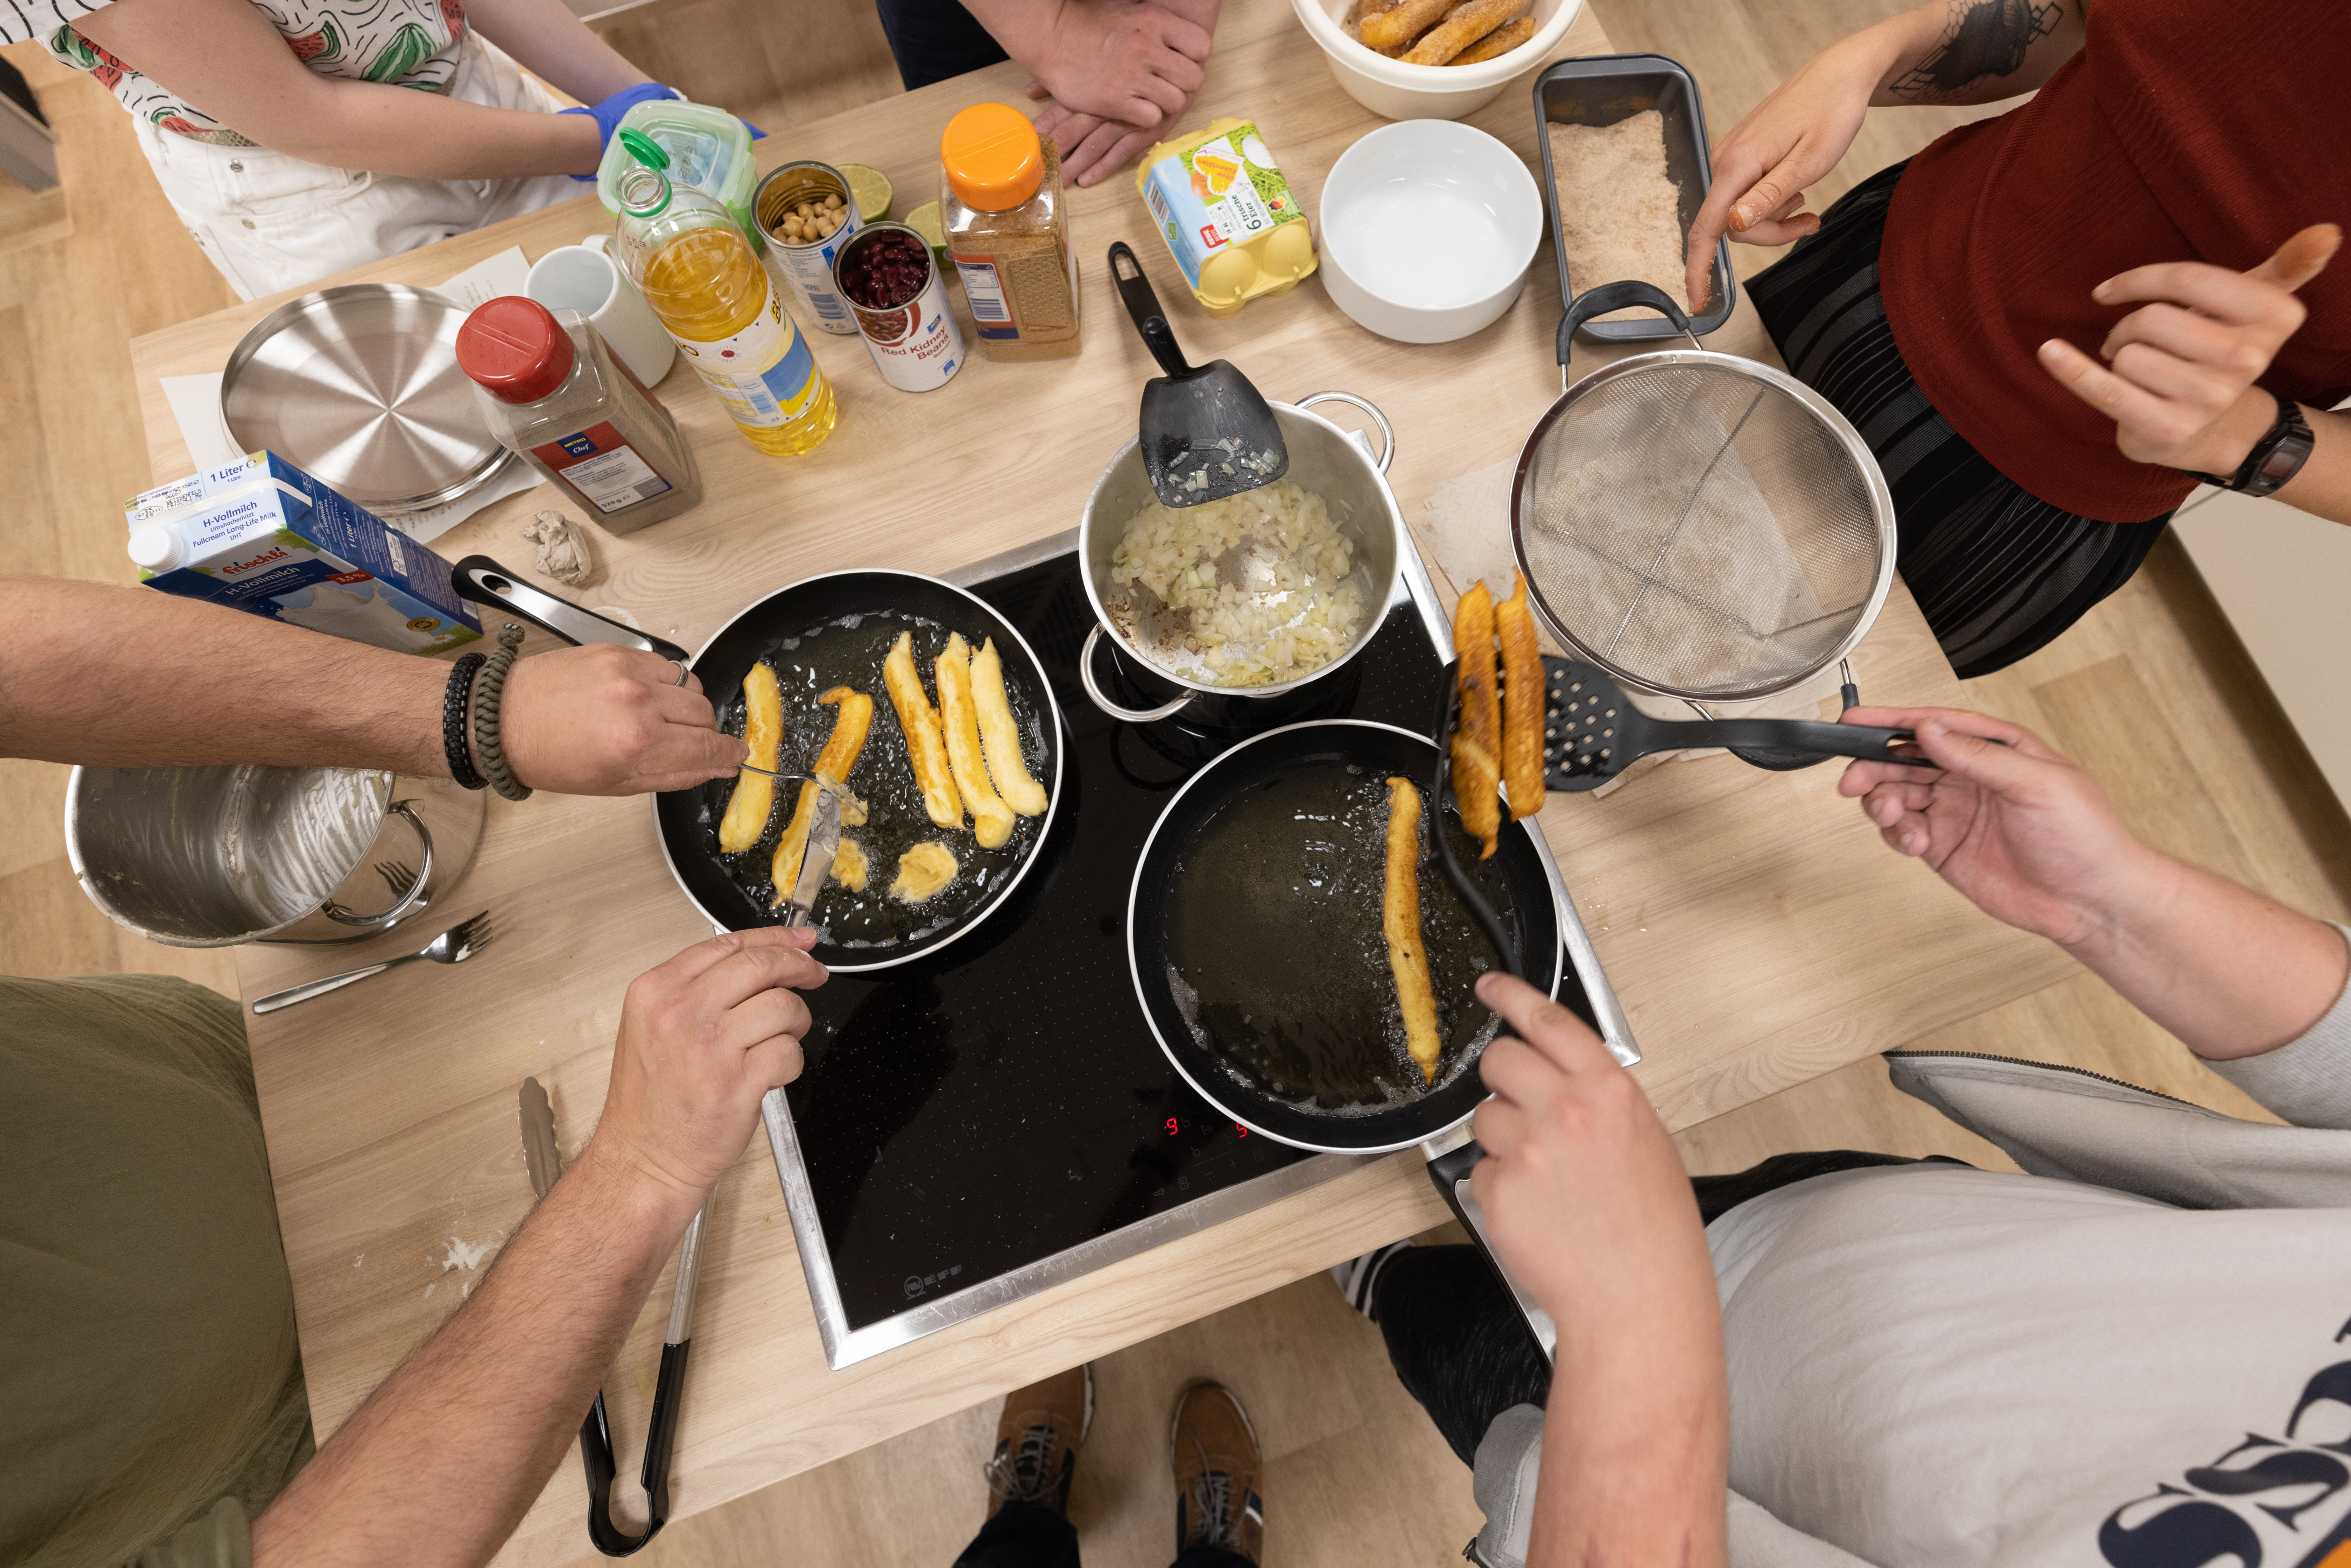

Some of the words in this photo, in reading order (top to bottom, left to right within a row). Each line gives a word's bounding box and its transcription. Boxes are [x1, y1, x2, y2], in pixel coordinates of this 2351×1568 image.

[1198, 159, 1237, 174] Kükentöten
[1217, 171, 1234, 181] Ohne
[1232, 195, 1249, 221] frische
[1245, 202, 1258, 218] Eier
[1247, 220, 1261, 230] 6
[1203, 229, 1215, 245] REWE
[1209, 228, 1221, 241] BESTE
[881, 347, 906, 355] Red
[910, 325, 945, 353] Kidney
[917, 334, 948, 360] Beans
[713, 345, 740, 355] QUALITÄTS
[717, 353, 742, 362] GARANTIE
[564, 438, 586, 447] METRO
[573, 444, 588, 453] Chef
[210, 474, 216, 482] 1
[219, 465, 243, 479] Liter
[149, 486, 172, 496] mindestens
[203, 501, 257, 528] H-Vollmilch
[210, 512, 254, 532] Ultrahocherhitzt
[318, 501, 330, 535] H-Vollmilch
[193, 531, 226, 547] Fullcream
[227, 518, 258, 535] Long-Life
[260, 511, 277, 522] Milk
[230, 532, 242, 540] UHT
[346, 522, 355, 543] Liter
[222, 546, 288, 574] frischli
[225, 567, 300, 595] H-Vollmilch
[336, 573, 366, 583] 3,5%
[1166, 1117, 1178, 1136] 9
[1236, 1122, 1247, 1138] 5
[904, 1264, 962, 1300] NEFF
